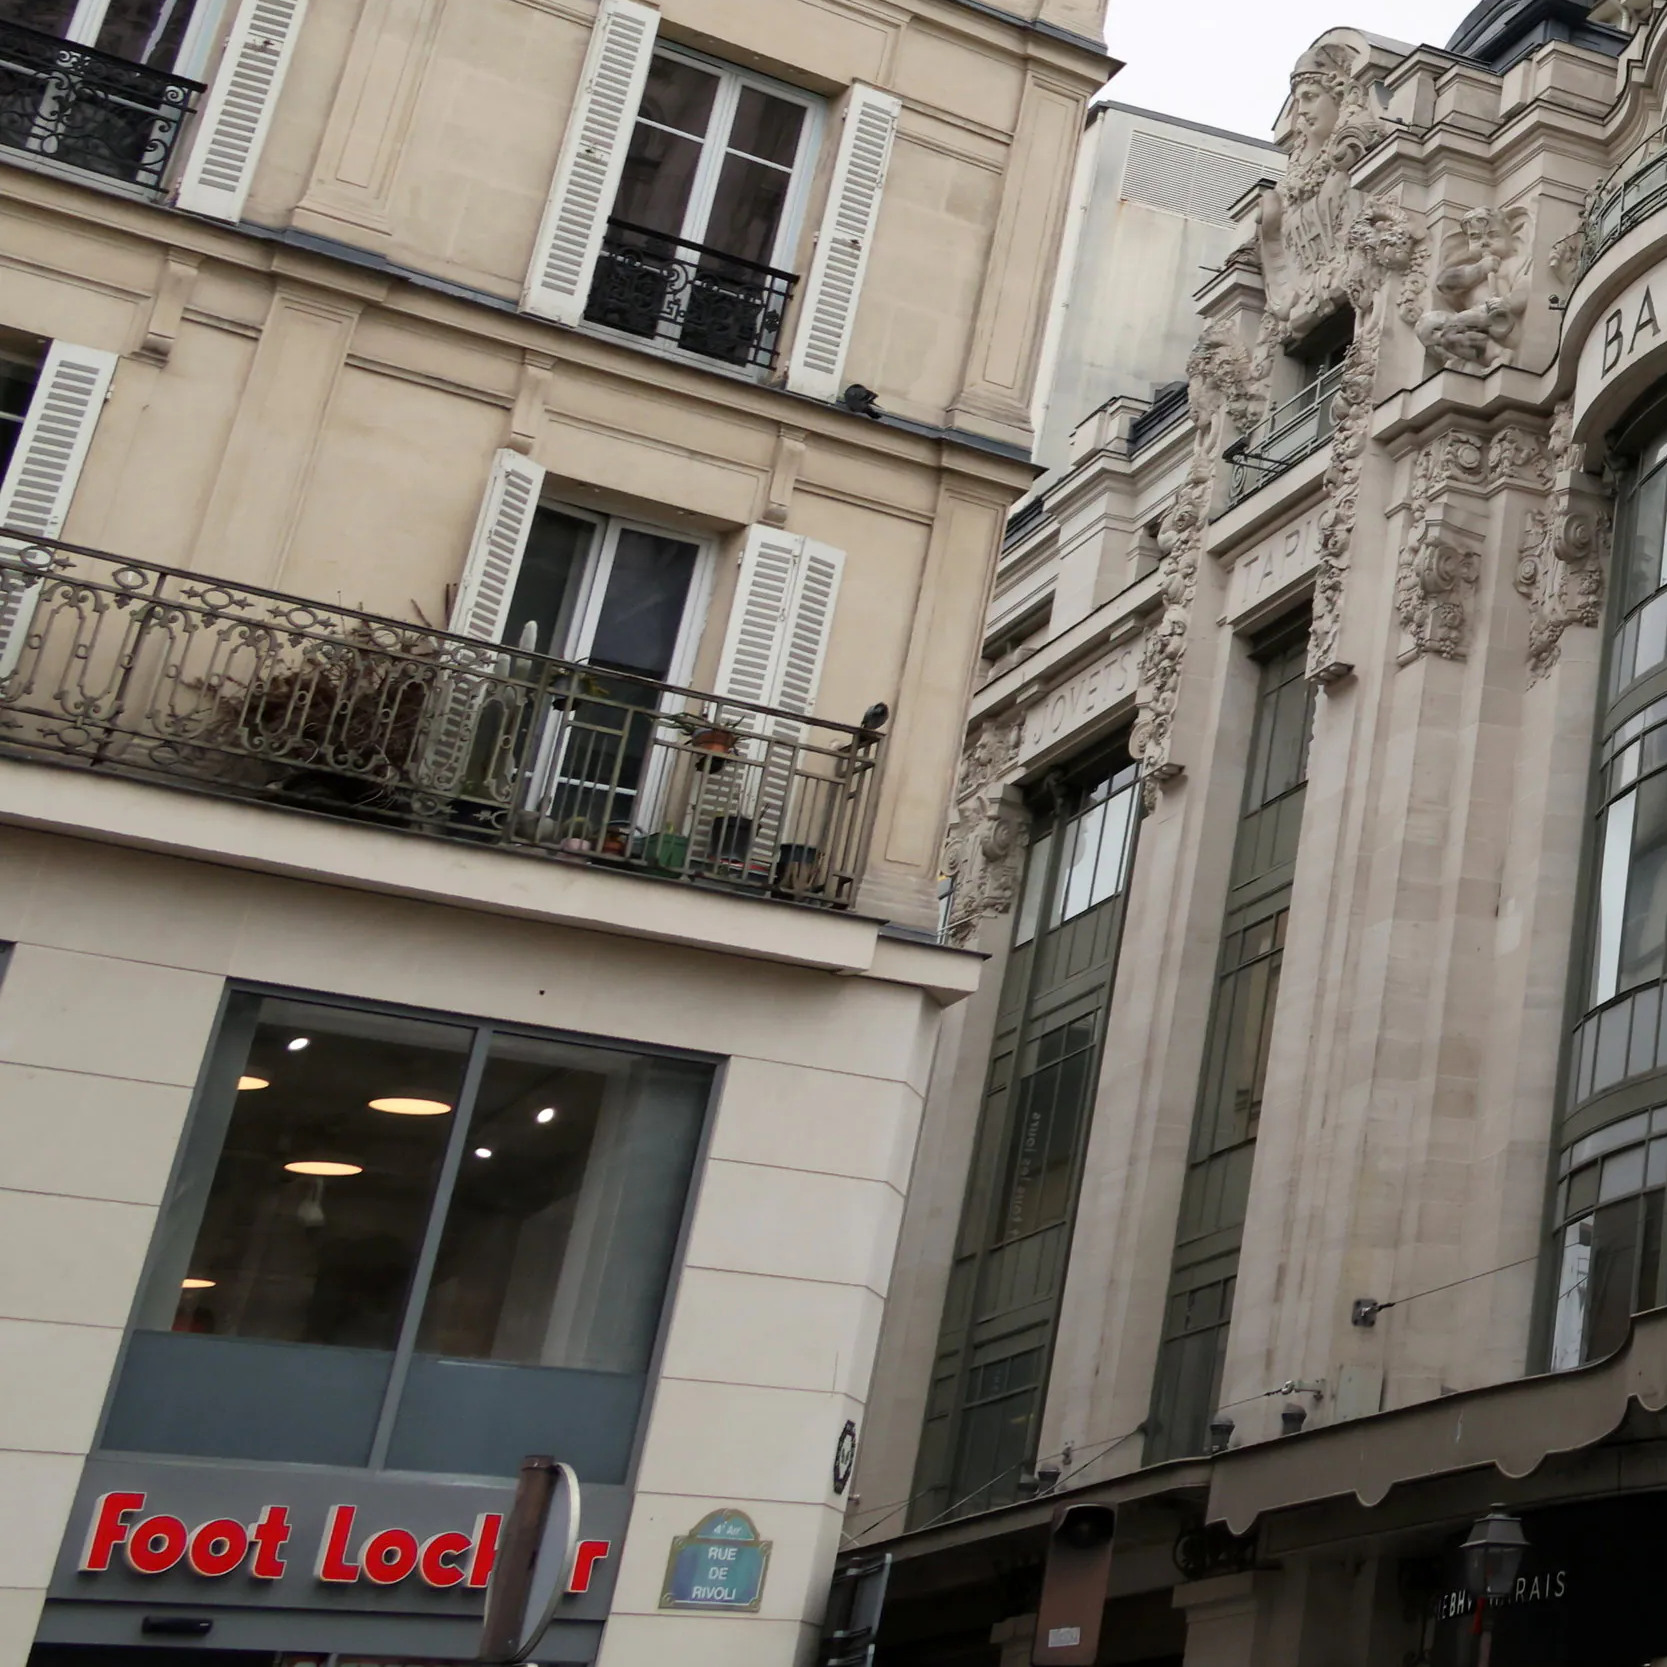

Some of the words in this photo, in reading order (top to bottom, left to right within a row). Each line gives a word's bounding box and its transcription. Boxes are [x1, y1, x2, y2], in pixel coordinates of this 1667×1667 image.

[79, 1491, 293, 1580] Foot
[708, 1547, 738, 1560] RUE
[708, 1567, 728, 1580] DE
[692, 1586, 736, 1600] RIVOLI
